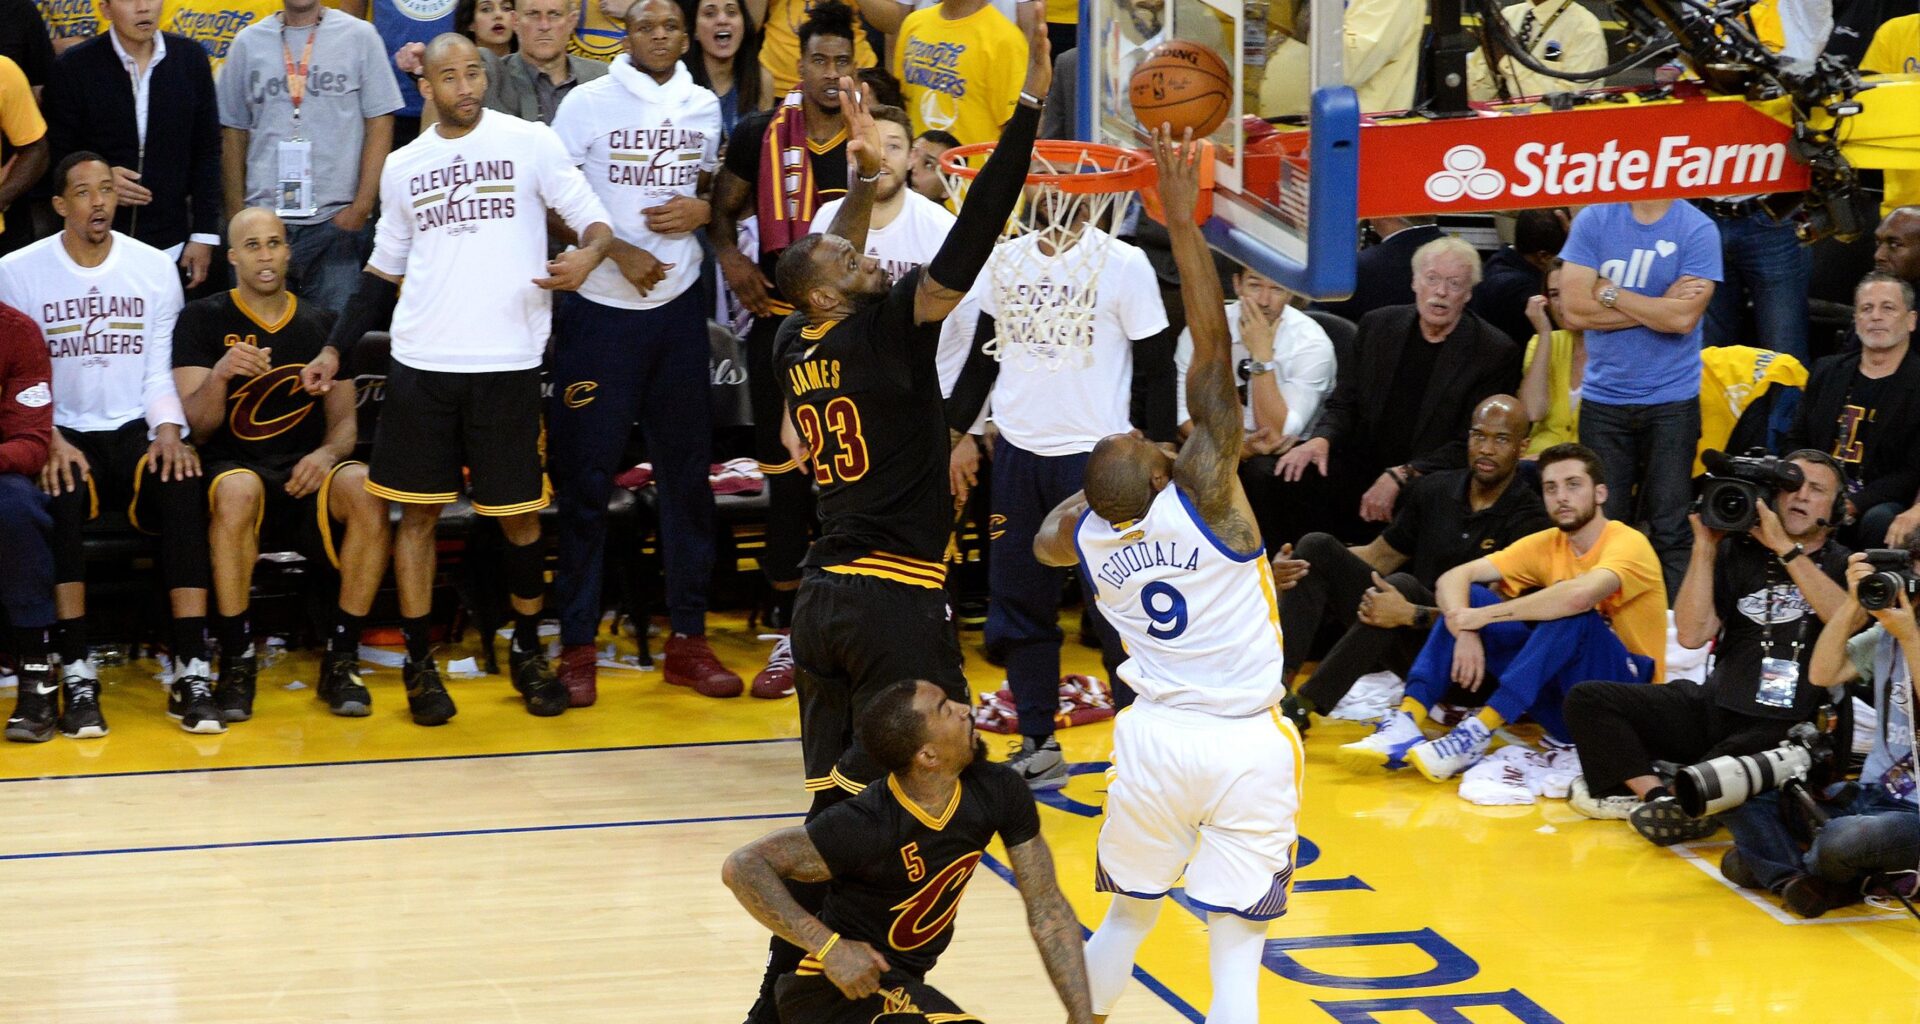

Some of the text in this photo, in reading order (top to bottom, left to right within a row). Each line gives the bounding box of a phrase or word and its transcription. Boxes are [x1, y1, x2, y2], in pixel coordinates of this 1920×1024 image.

[249, 64, 348, 104] Coies
[410, 160, 514, 197] CLEVELAND
[416, 198, 515, 232] CAVALIERS
[43, 296, 144, 323] CLEVELAND
[49, 334, 144, 359] CAVALIERS
[789, 359, 841, 397] JAMES
[796, 396, 870, 485] 23
[1098, 541, 1199, 590] IGUODALA
[1140, 580, 1188, 641] 9
[901, 841, 926, 882] 5
